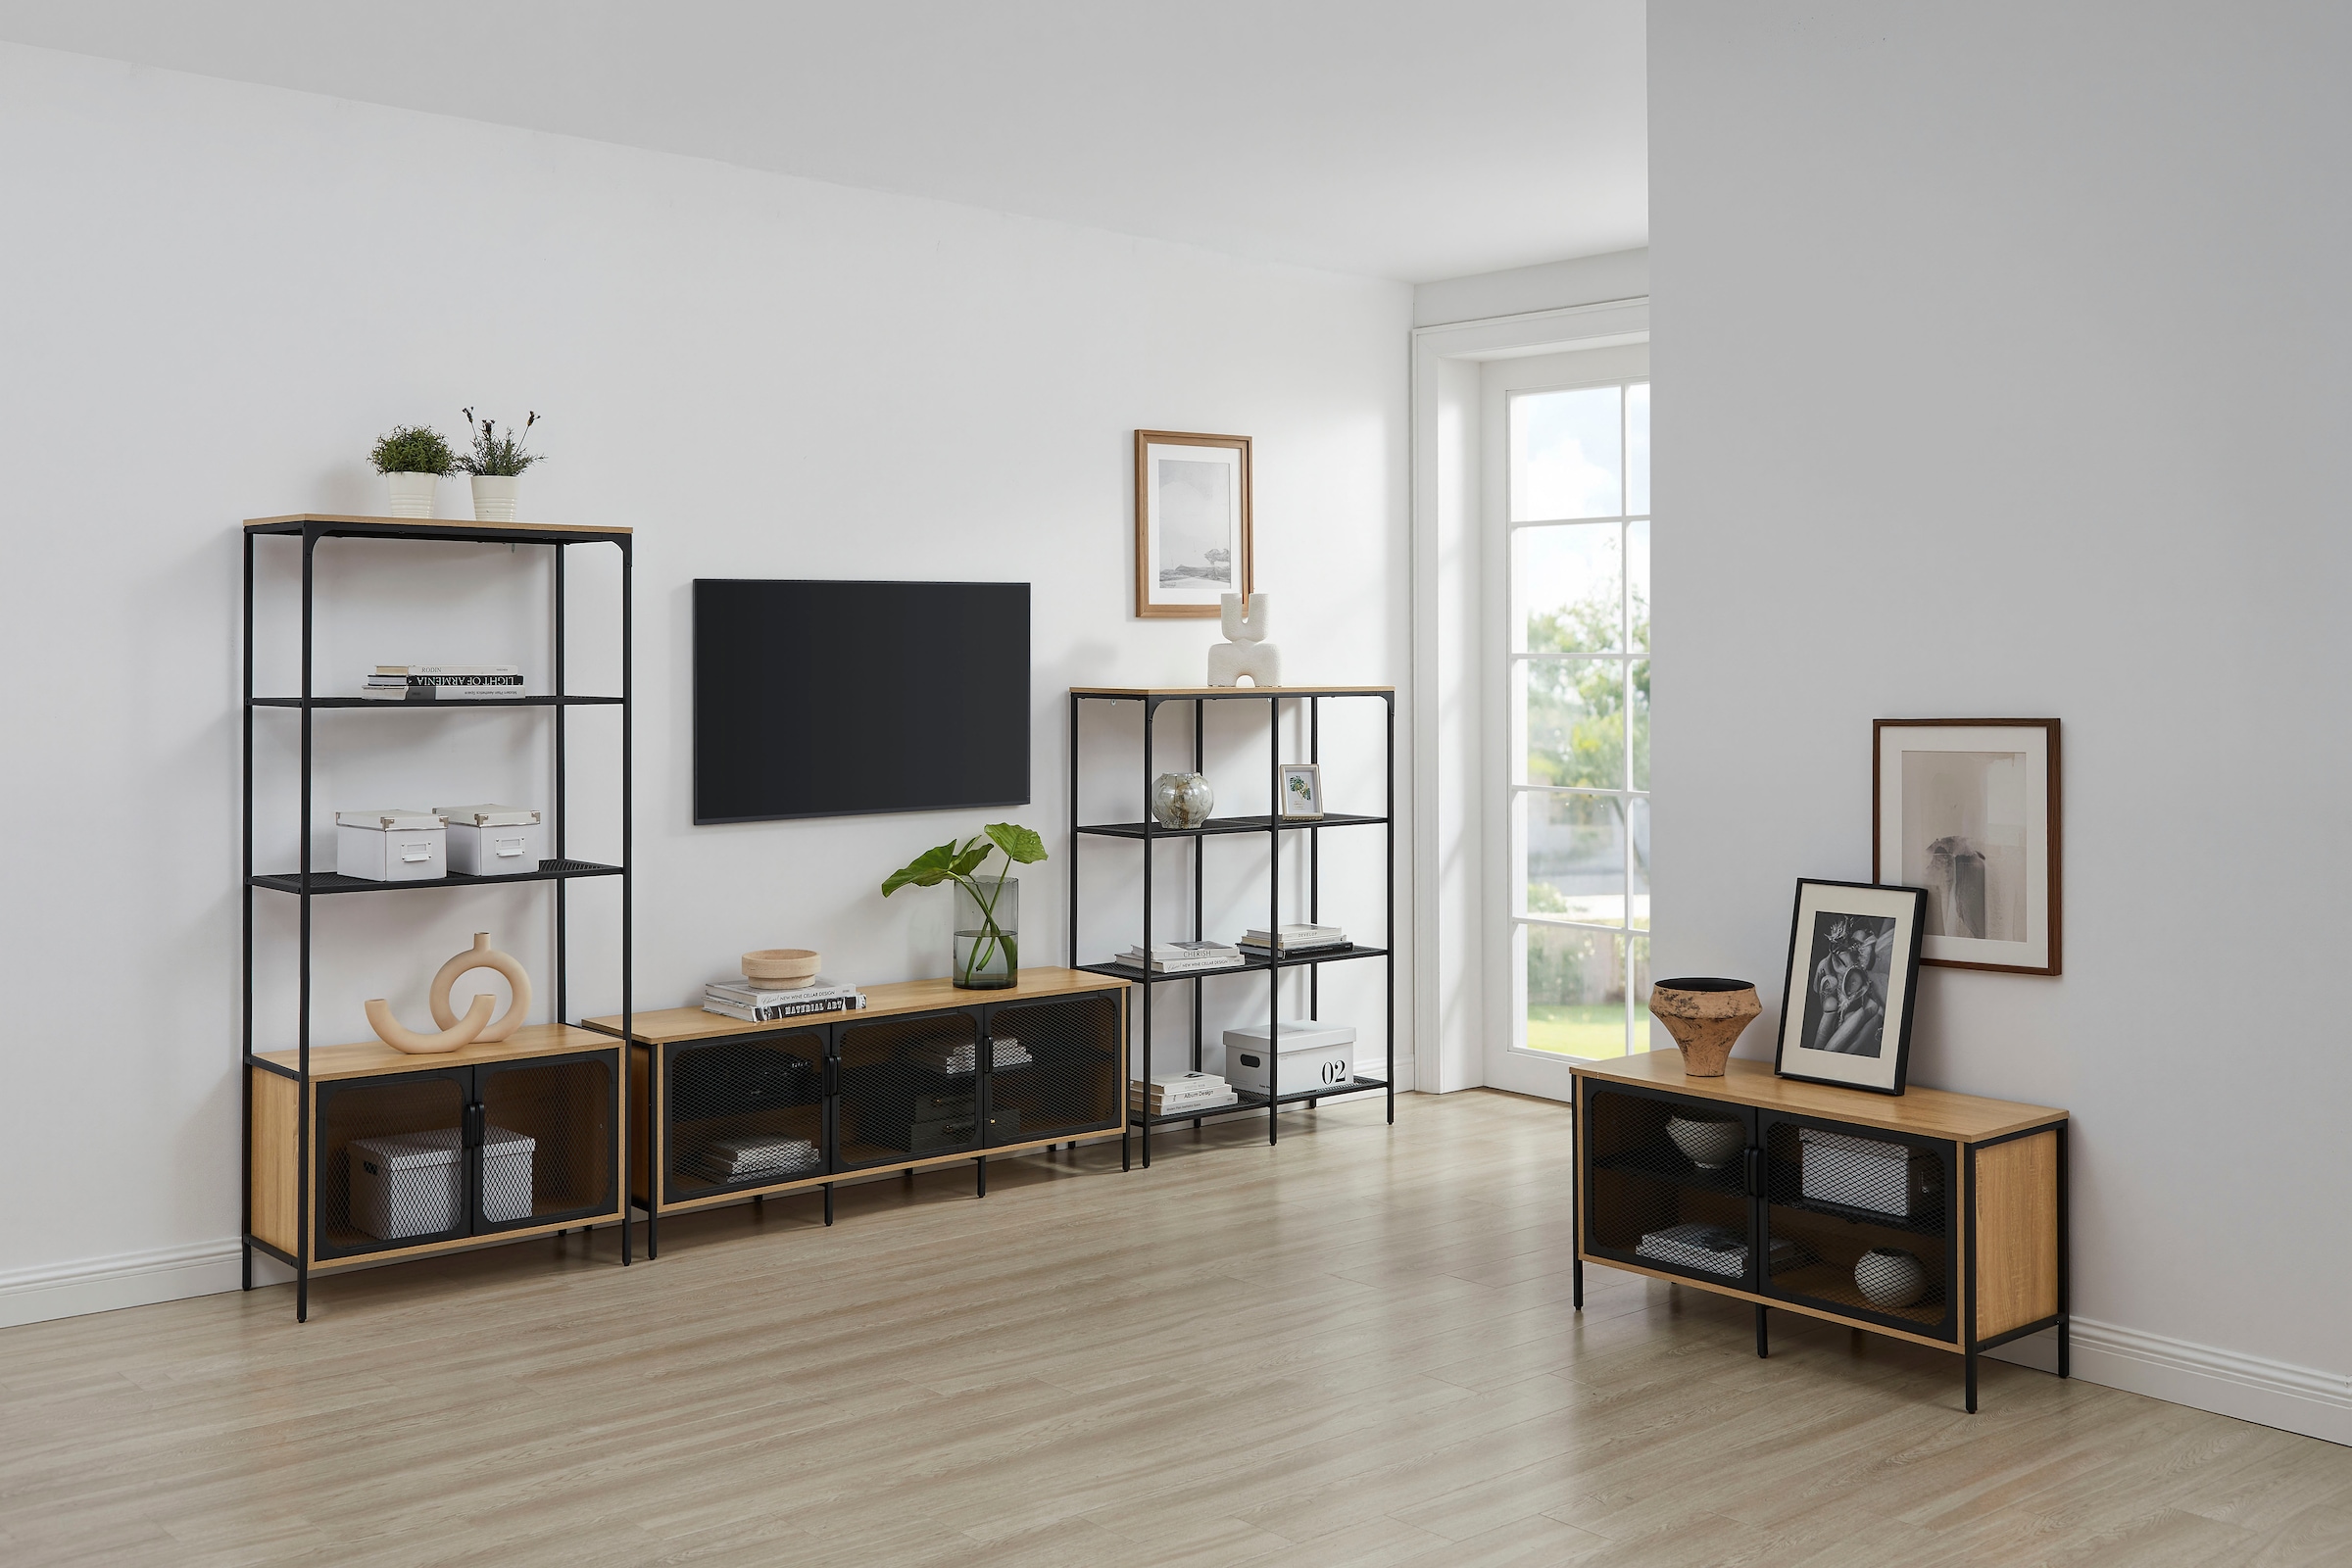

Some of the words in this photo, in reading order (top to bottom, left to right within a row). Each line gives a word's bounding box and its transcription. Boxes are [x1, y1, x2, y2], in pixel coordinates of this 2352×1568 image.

[416, 676, 466, 686] ARMENIA
[466, 676, 481, 686] OF
[483, 676, 514, 686] LIGHT
[785, 1002, 824, 1015] MATERIAL
[827, 1000, 843, 1010] ART
[1321, 1059, 1347, 1085] 02
[1184, 1090, 1199, 1100] Album
